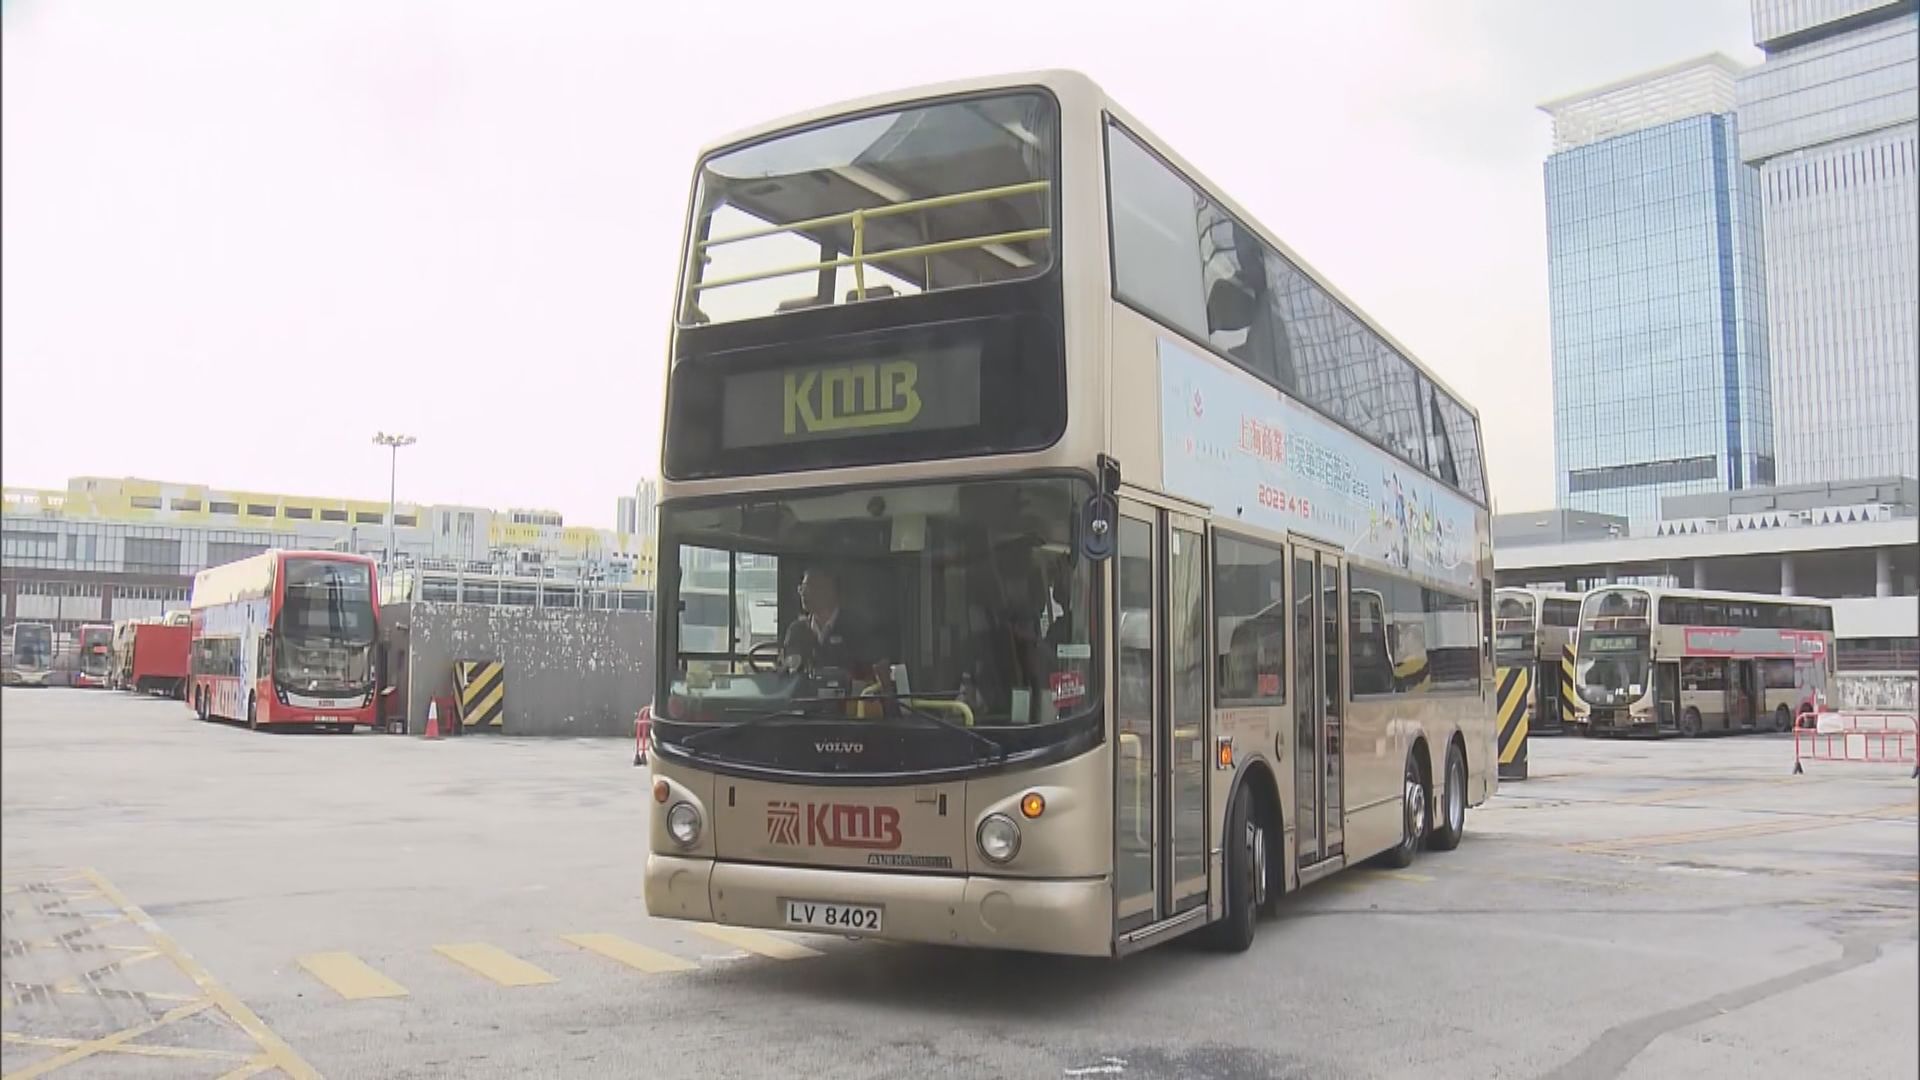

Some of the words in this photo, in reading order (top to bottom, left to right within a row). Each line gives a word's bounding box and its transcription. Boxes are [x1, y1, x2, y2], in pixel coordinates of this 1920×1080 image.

[784, 360, 922, 435] KMB
[1258, 484, 1285, 512] 2023
[815, 742, 864, 753] VOLVO
[807, 802, 902, 850] KMB
[791, 903, 816, 923] LV
[825, 907, 878, 929] 8402
